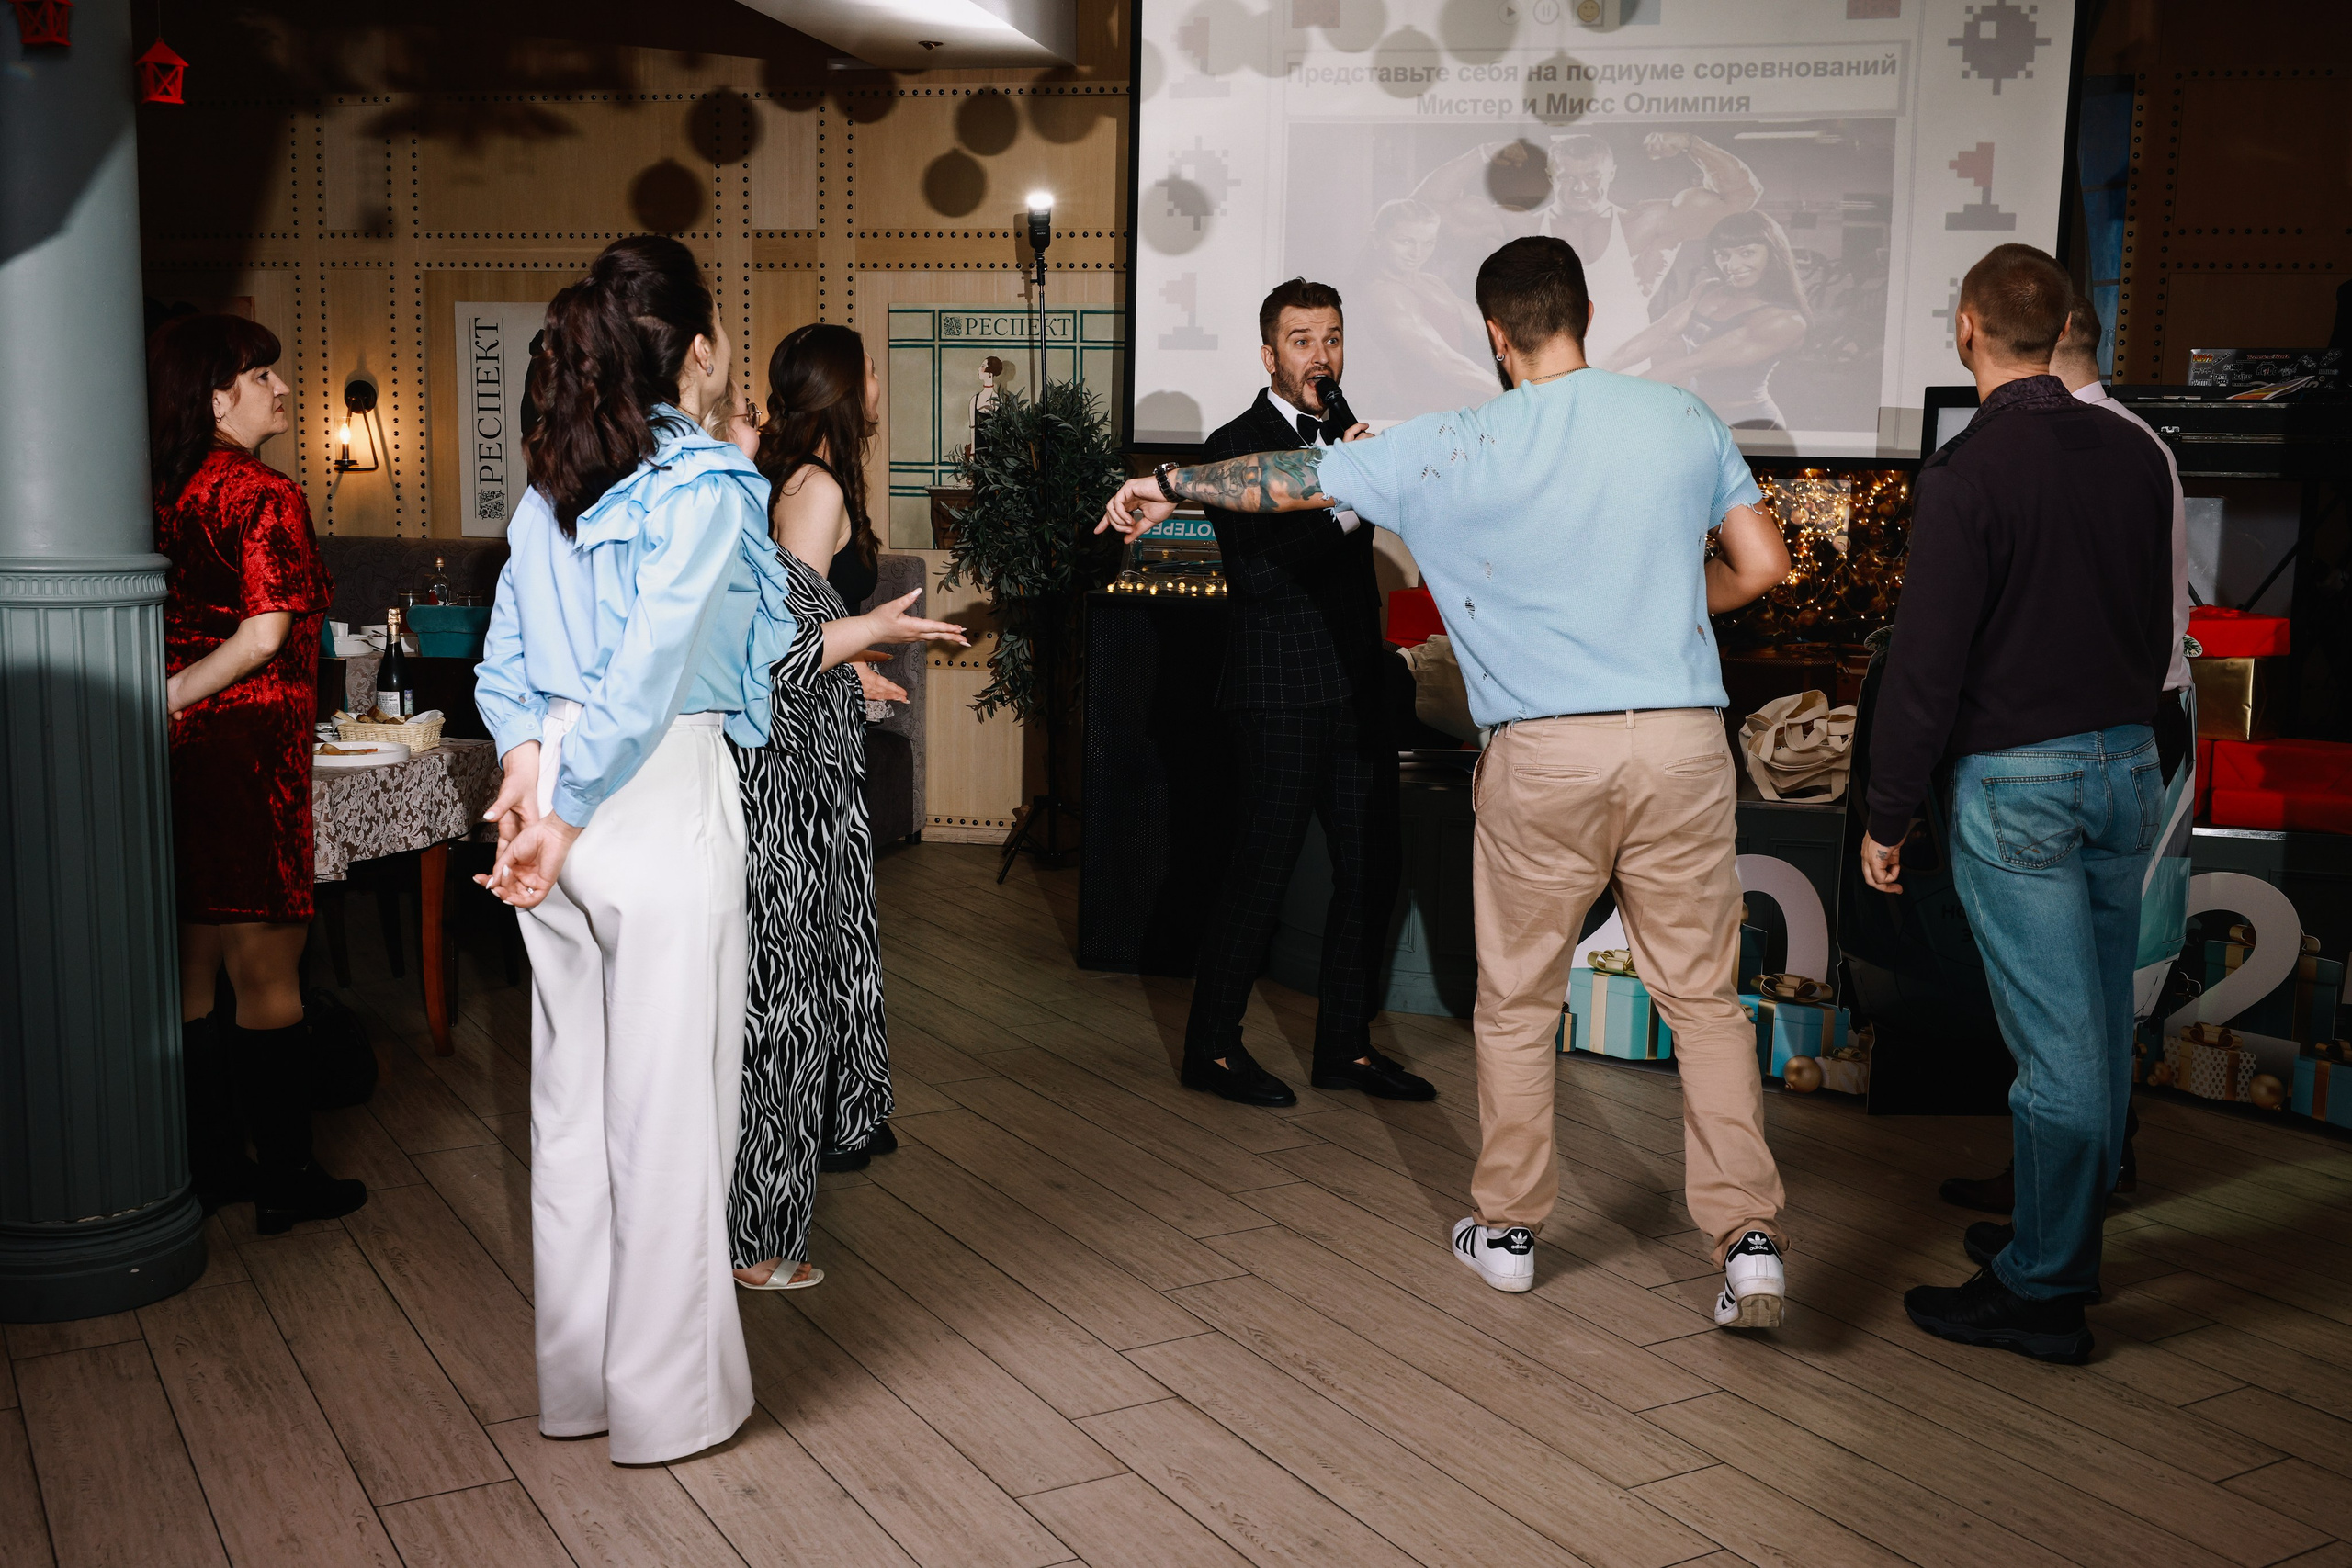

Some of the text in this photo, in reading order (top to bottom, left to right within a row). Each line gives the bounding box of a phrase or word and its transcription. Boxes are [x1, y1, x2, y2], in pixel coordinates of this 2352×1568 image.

[1286, 52, 1897, 87] Представьте себя на подиуме соревнований
[1415, 91, 1751, 118] Мистер и Мисс Олимпия
[965, 317, 1071, 336] РЕСПЕКТ
[474, 317, 503, 485] РЕСПЕКТ
[1144, 522, 1216, 537] ОТЕРЕ
